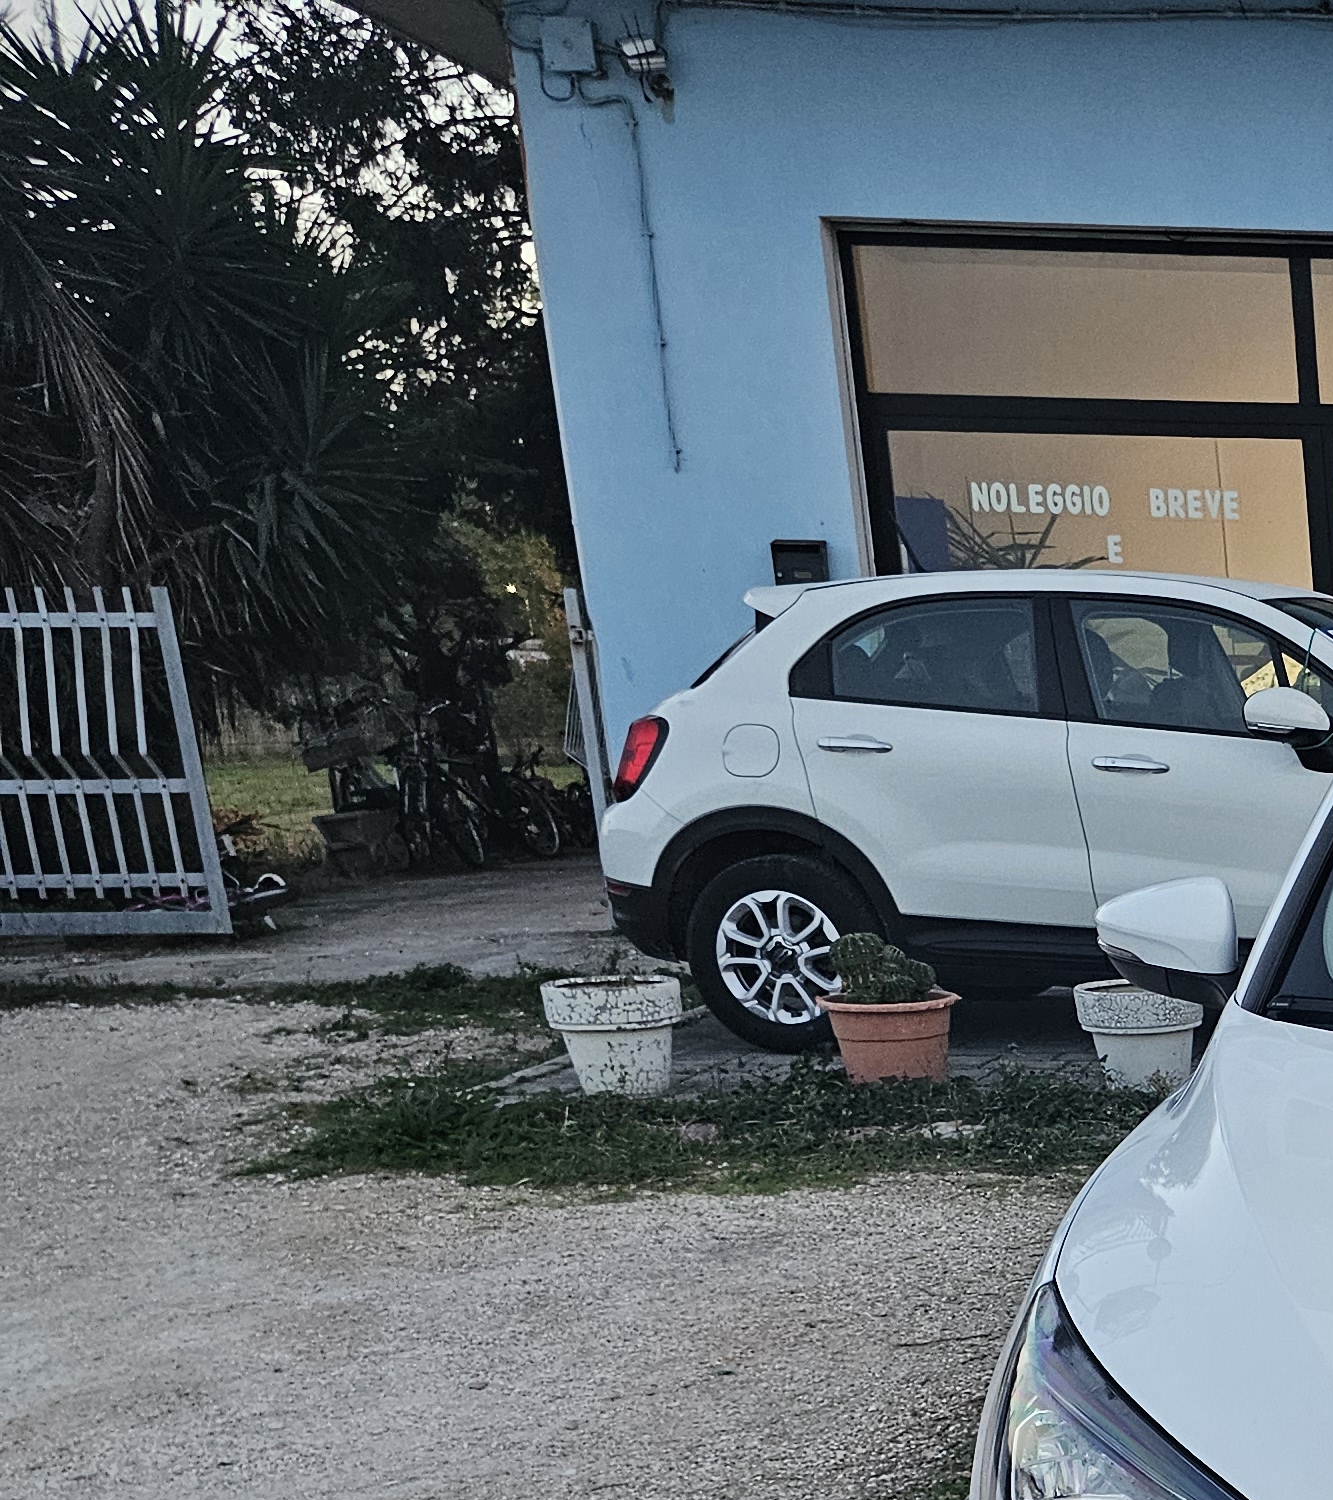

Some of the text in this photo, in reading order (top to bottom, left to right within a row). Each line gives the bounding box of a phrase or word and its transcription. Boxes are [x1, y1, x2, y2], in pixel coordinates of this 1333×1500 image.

[971, 481, 1240, 521] NOLEGGIO BREVE
[1107, 534, 1124, 564] E
